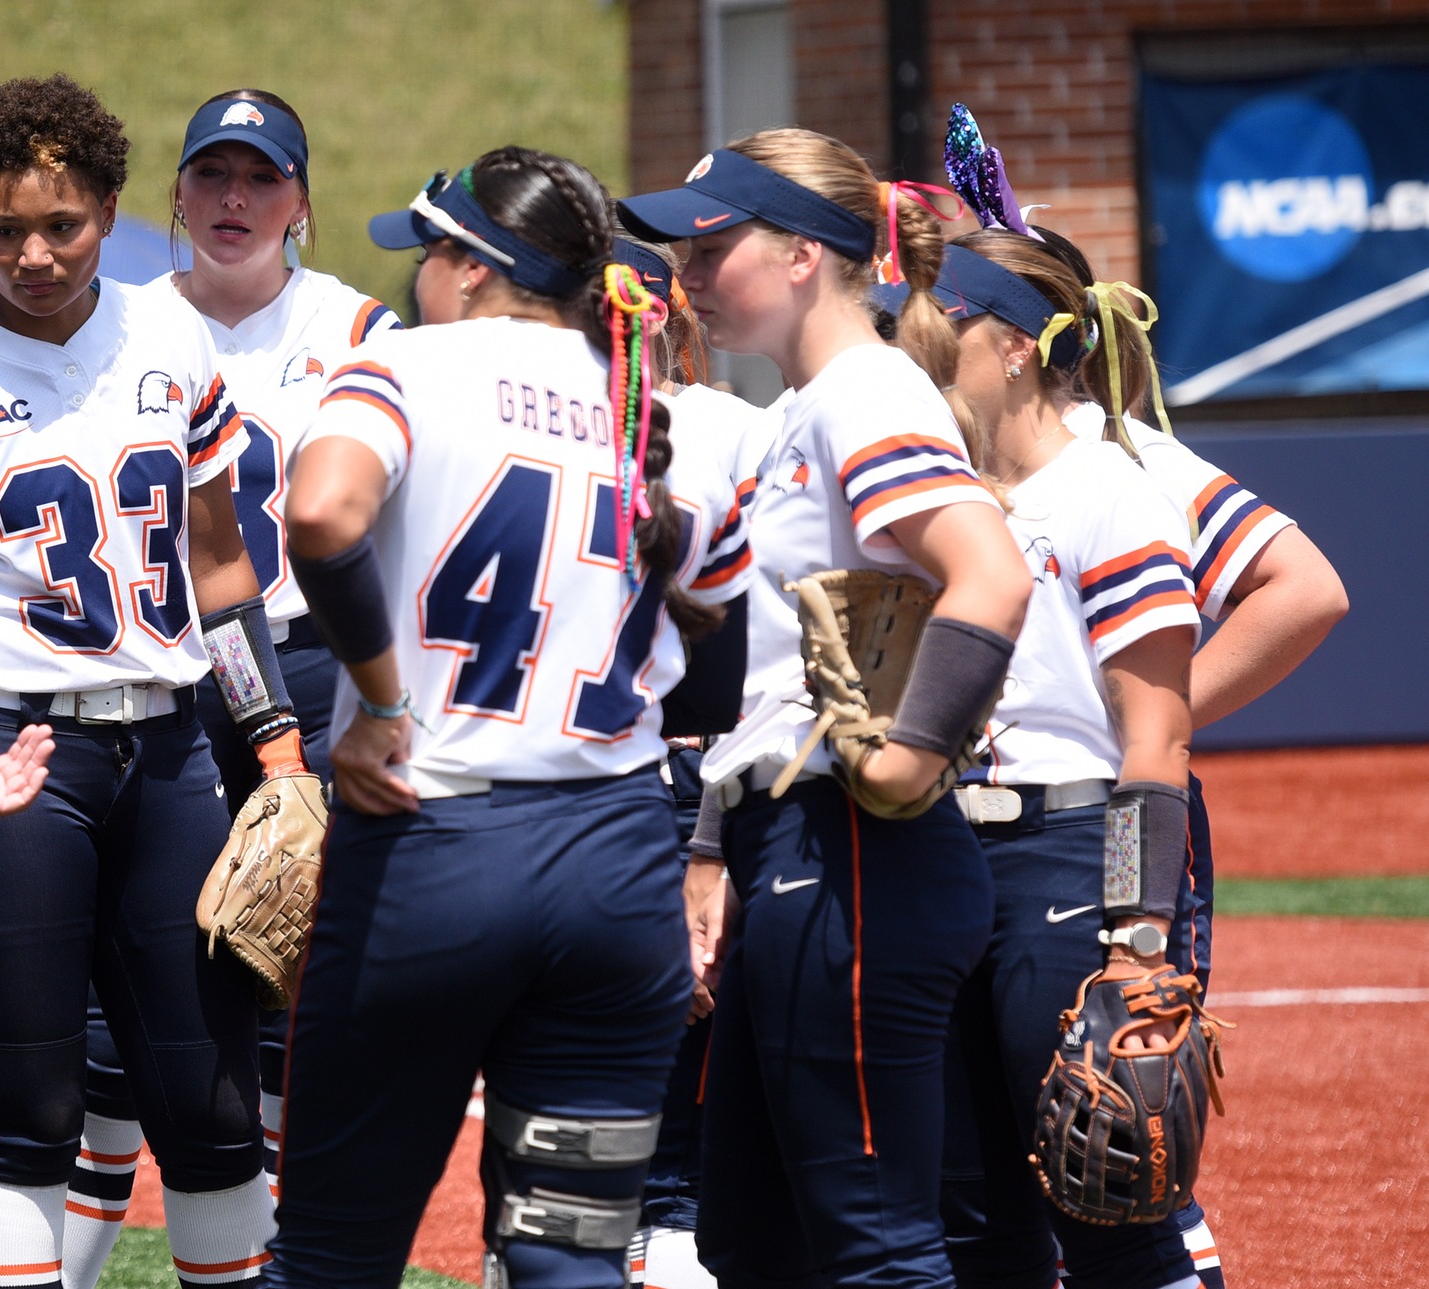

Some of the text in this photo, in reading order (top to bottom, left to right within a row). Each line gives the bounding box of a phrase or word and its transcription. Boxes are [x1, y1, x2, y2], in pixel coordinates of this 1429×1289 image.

[496, 378, 614, 447] GREGO
[417, 453, 701, 744] 47
[242, 850, 272, 893] Smith
